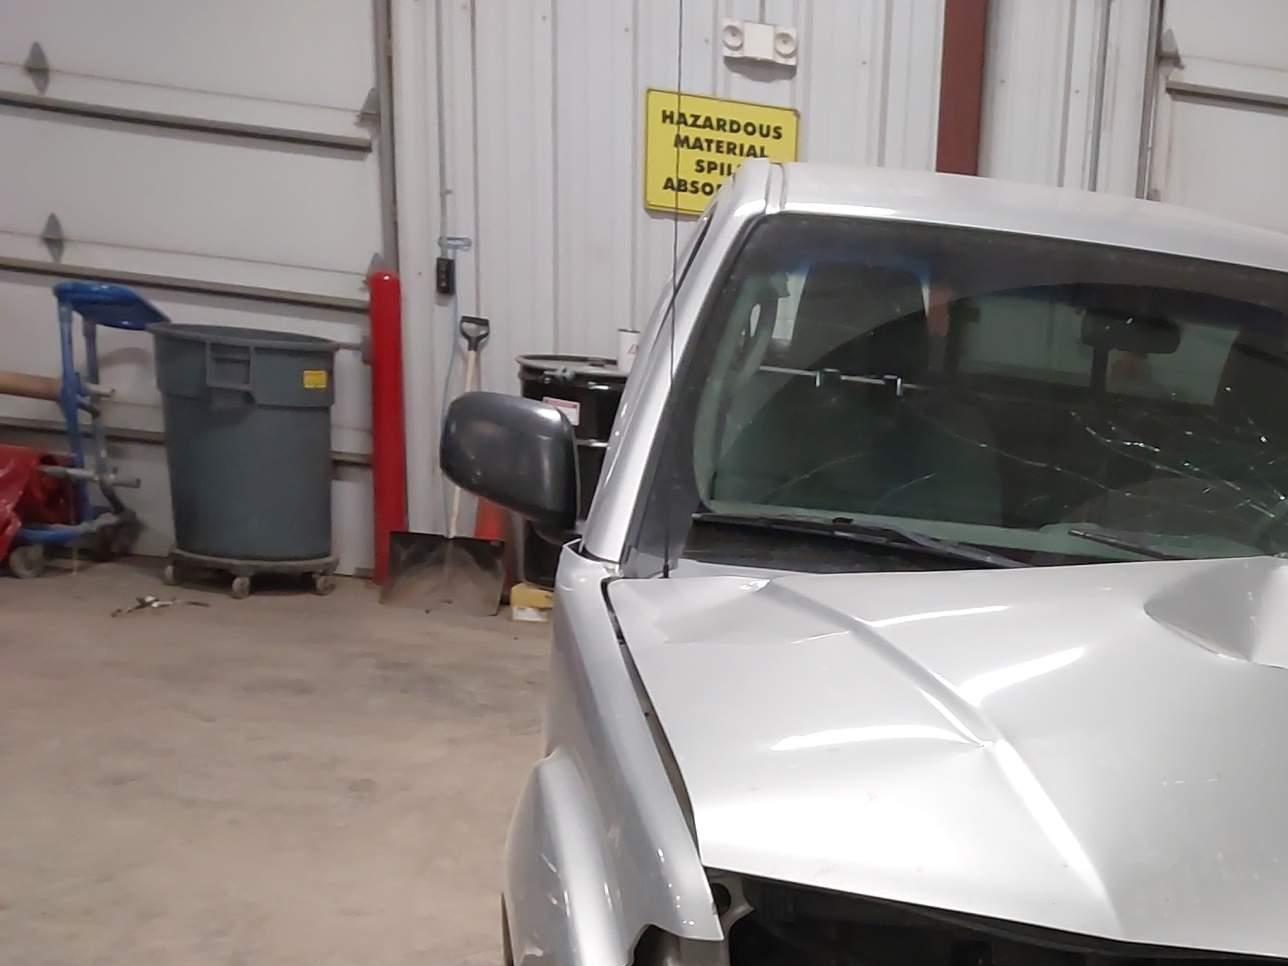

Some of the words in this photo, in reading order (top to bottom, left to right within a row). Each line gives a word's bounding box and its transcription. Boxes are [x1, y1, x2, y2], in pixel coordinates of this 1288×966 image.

[661, 109, 783, 140] HAZARDOUS
[673, 134, 769, 158] MATERIAL
[662, 177, 722, 196] ABSO
